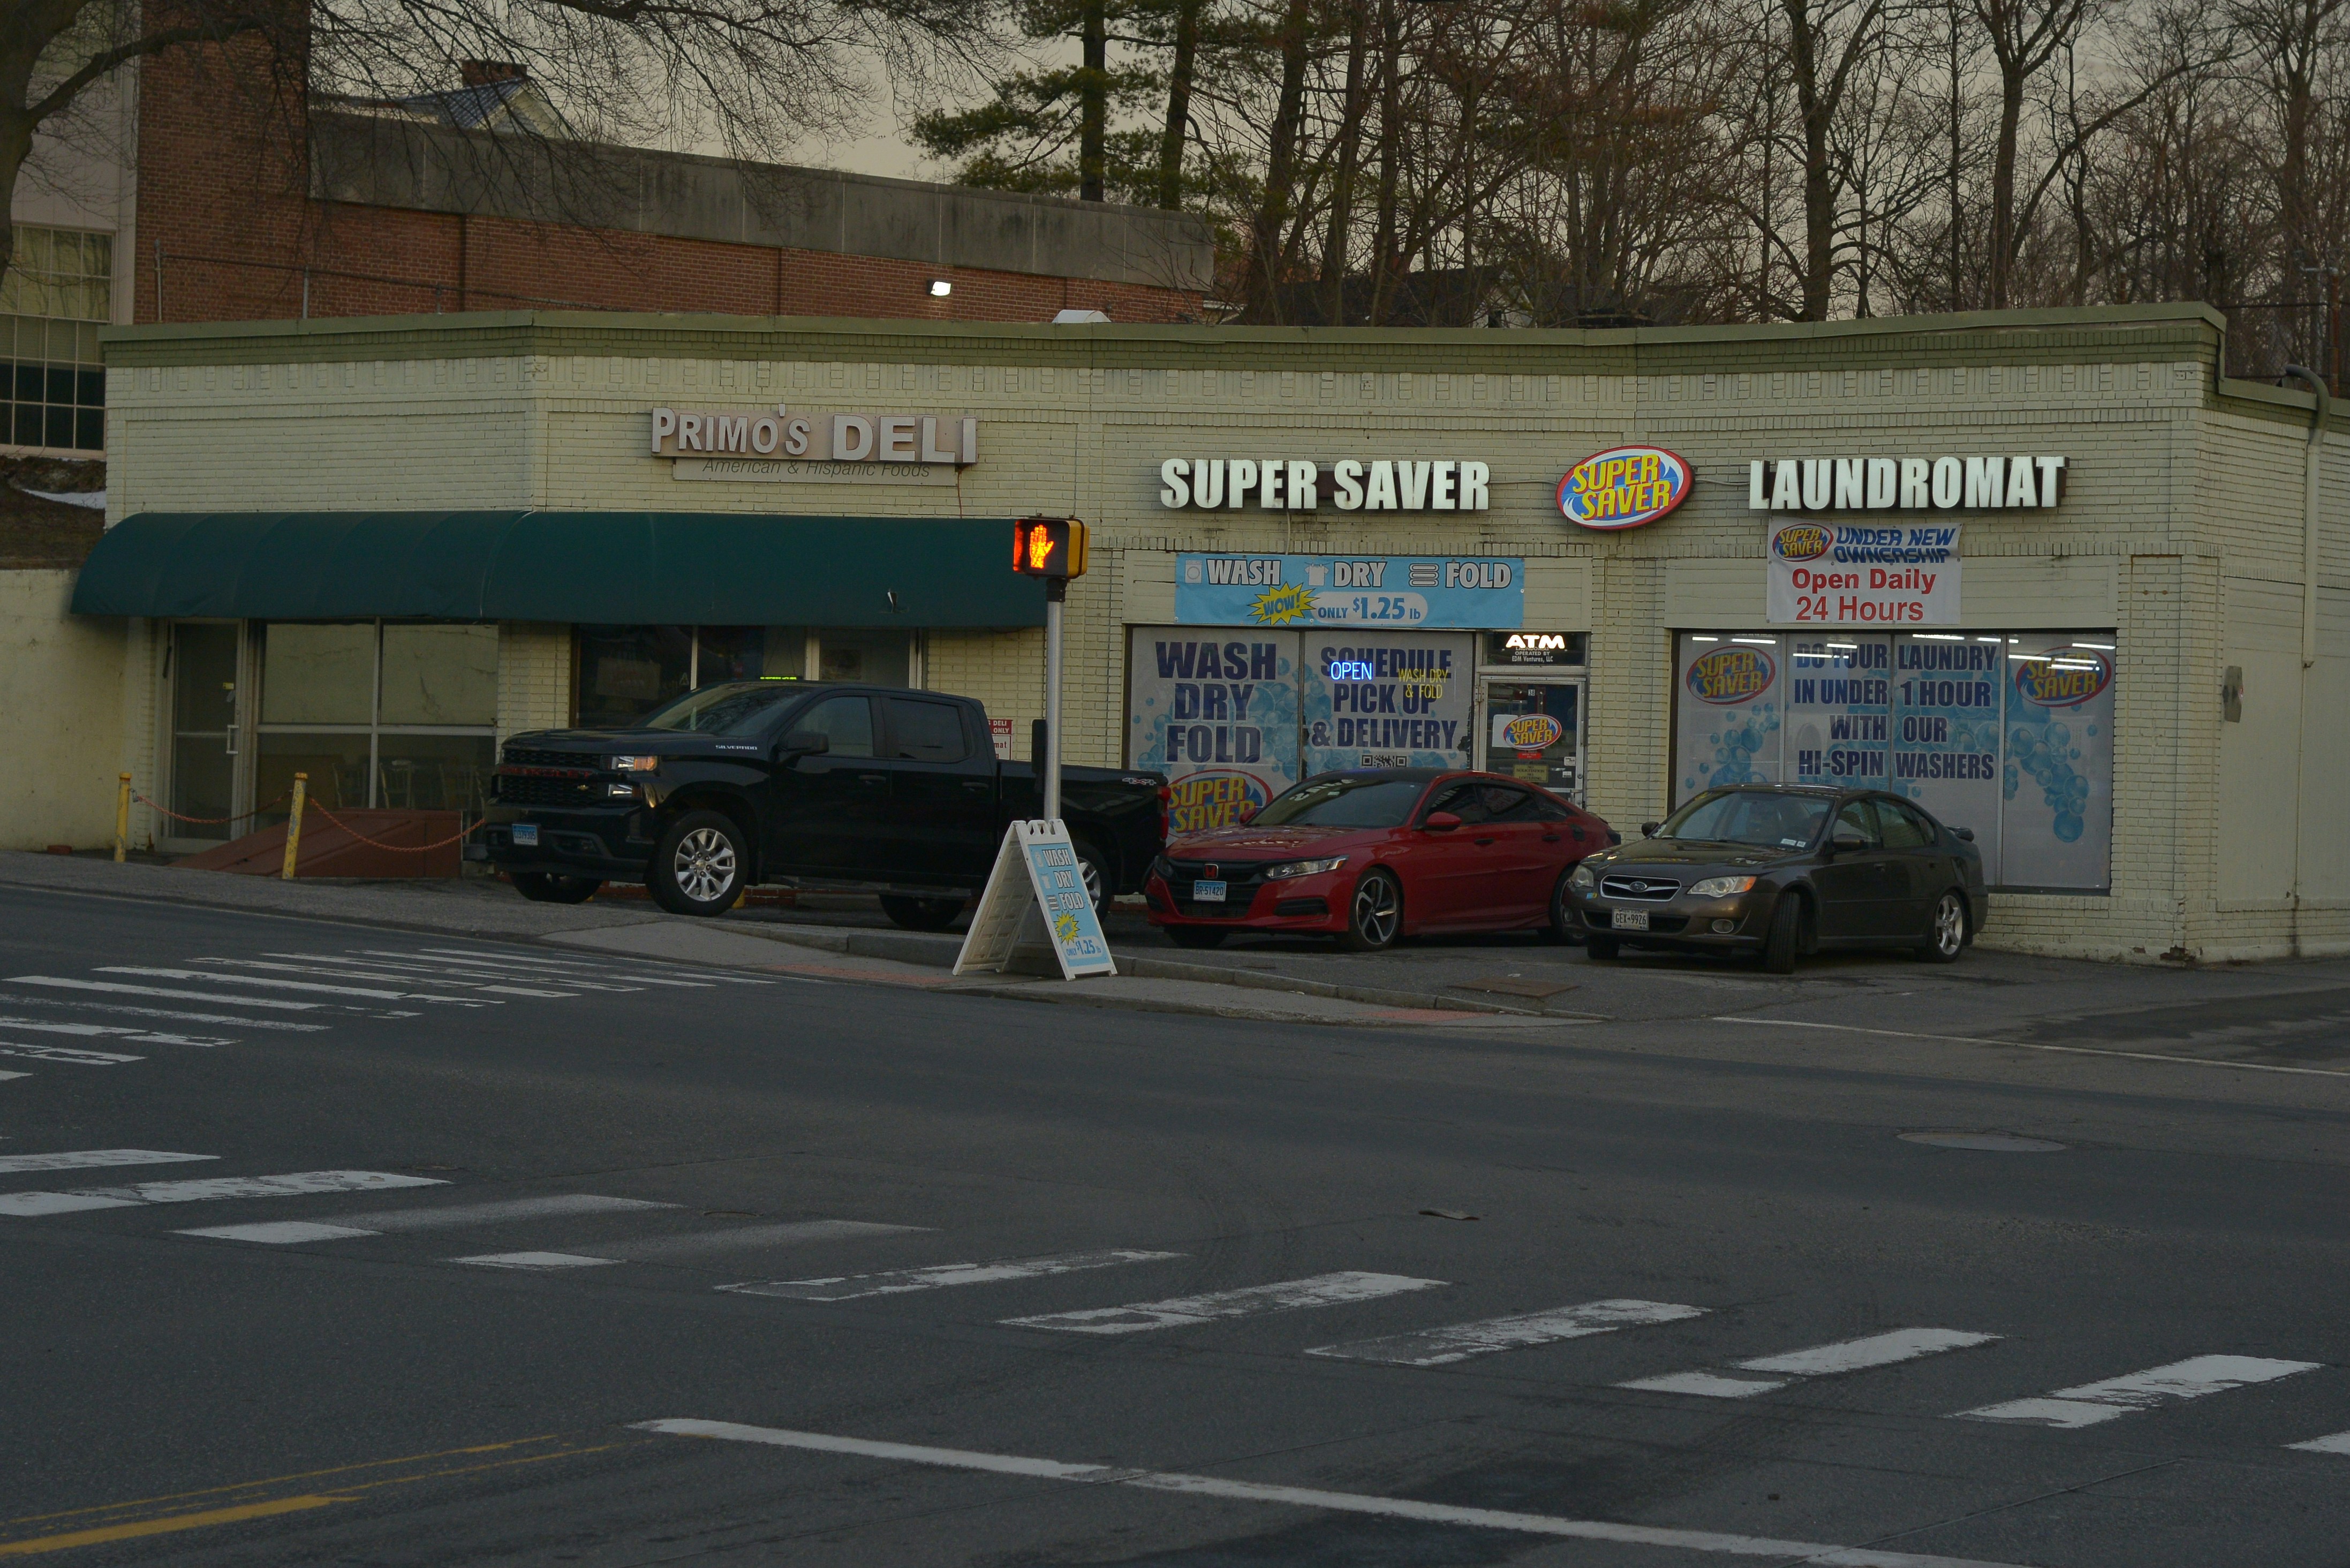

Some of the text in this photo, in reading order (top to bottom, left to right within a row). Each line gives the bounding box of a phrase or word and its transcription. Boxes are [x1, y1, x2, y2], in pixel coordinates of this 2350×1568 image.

[652, 404, 977, 463] PRIMO'S DELI
[702, 458, 931, 478] American & Hispanic Foods
[1572, 453, 1662, 494] SUPER
[1160, 458, 1490, 510] SUPER SAVER
[1749, 456, 2068, 510] LAUNDROMAT
[1580, 480, 1673, 520] SAVER
[1779, 527, 1821, 545] SUPER
[1782, 540, 1824, 558] SAVER
[1836, 526, 1956, 546] UNDER NEW
[1833, 546, 1951, 564] OWNERSHIP
[1206, 558, 1512, 589] WASH DRY FOLD
[1791, 568, 1937, 595] Open Daily
[1263, 591, 1301, 616] WOW!
[1318, 597, 1421, 620] ONLY $1.25 lb
[1795, 596, 1924, 621] 24 Hours
[1506, 634, 1566, 649] ATM
[1155, 641, 1276, 680] WASH
[1320, 646, 1452, 679] SCHEDULE
[1331, 661, 1372, 680] OPEN
[1695, 652, 1756, 679] SUPER
[1796, 643, 1997, 671] DO YOUR LAUNDRY
[1398, 668, 1448, 683] WASH DRY
[1701, 670, 1763, 699] SAVER
[2032, 672, 2098, 700] SAVER
[1174, 683, 1255, 721] DRY
[1333, 683, 1438, 714] PICK UP
[1405, 684, 1443, 699] & FOLD
[1794, 679, 1991, 707] IN UNDER 1 HOUR
[1312, 718, 1458, 749] & DELIVERY
[1509, 718, 1548, 734] SUPER
[1513, 729, 1553, 746] SAVER
[1830, 715, 1947, 743] WITH OUR
[1166, 725, 1262, 763] FOLD
[1799, 750, 1994, 779] HI-SPIN WASHERS
[1168, 777, 1245, 808] SUPER
[1173, 800, 1256, 832] SAVER
[1042, 849, 1072, 867] WASH
[1053, 870, 1075, 888] DRY
[1058, 891, 1085, 911] FOLD
